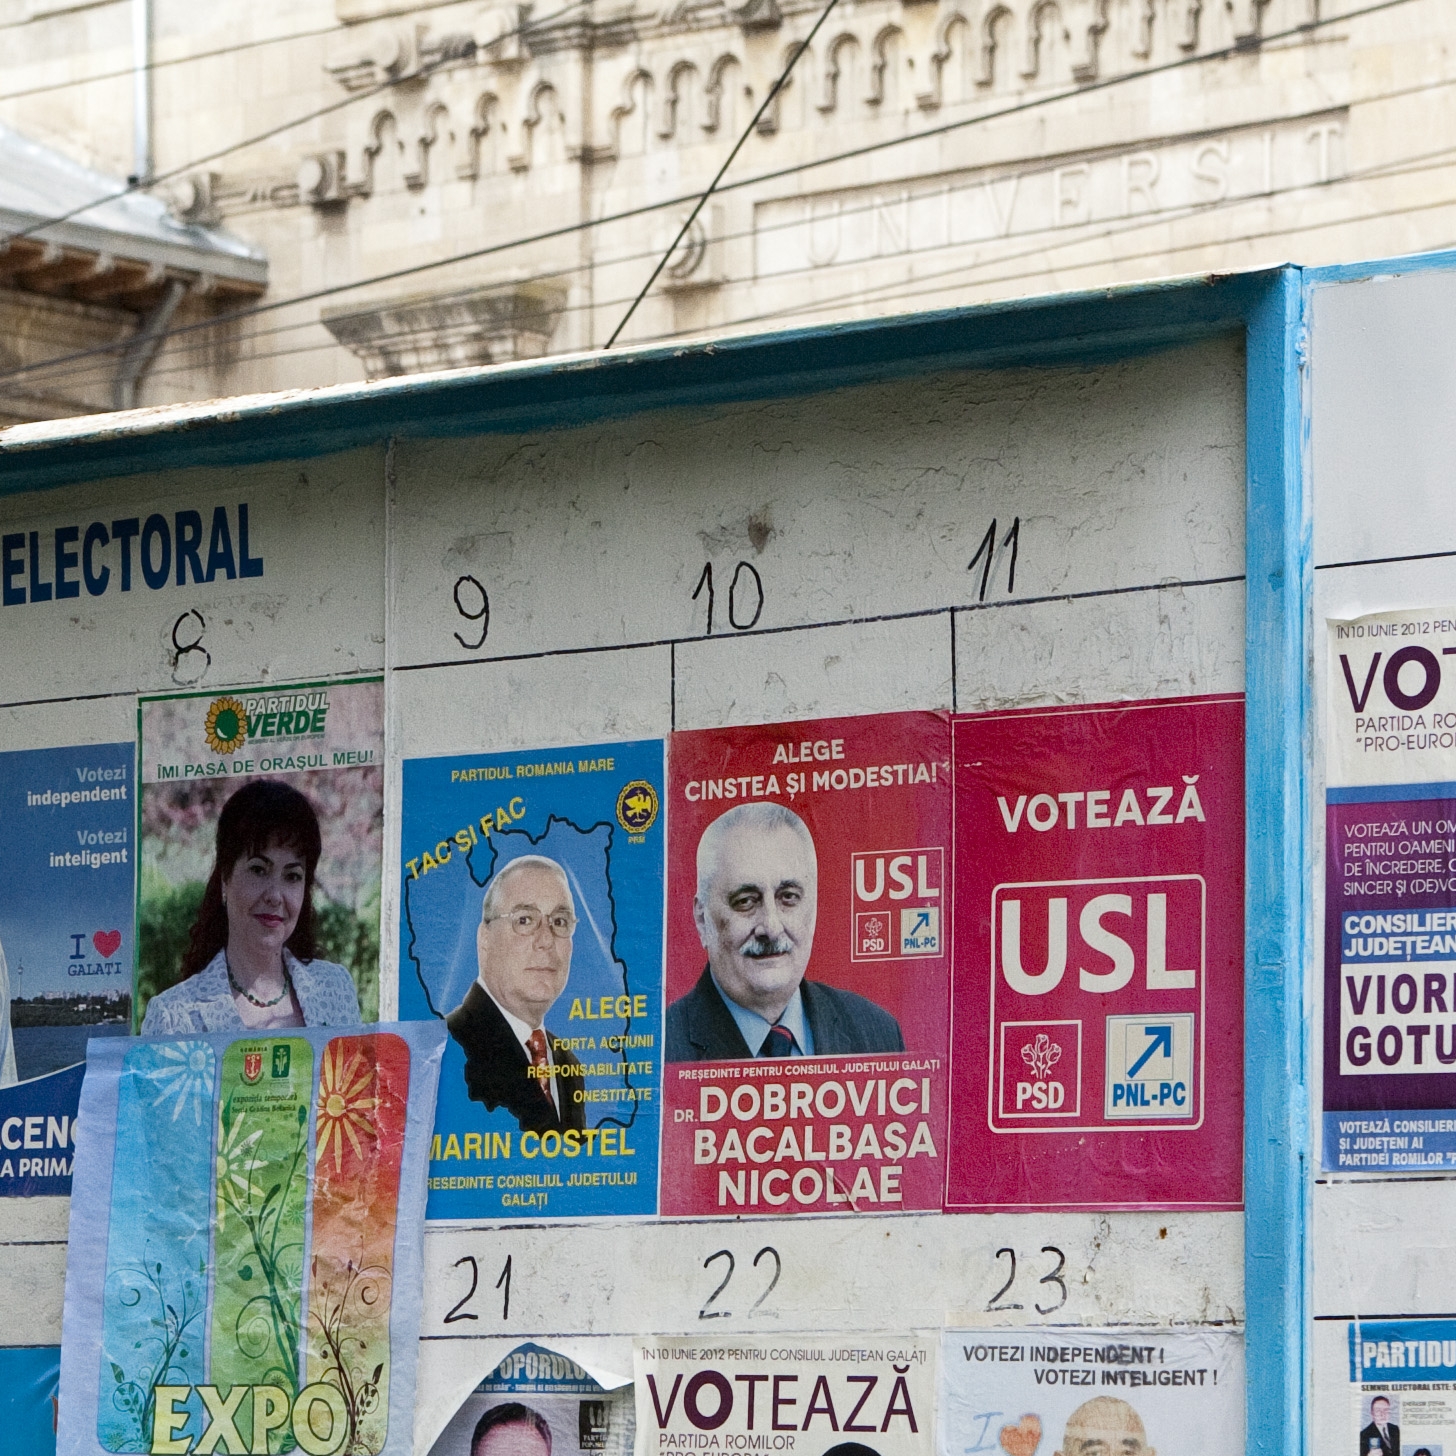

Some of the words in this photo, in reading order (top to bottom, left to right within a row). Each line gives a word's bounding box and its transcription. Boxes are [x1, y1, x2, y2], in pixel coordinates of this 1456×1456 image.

[2, 503, 264, 606] ELECTORAL
[968, 516, 1019, 601] 11
[454, 575, 489, 649] 9
[692, 561, 763, 634] 10
[171, 608, 211, 687] 8
[246, 692, 330, 716] PARTIDUL
[246, 709, 327, 738] VERDE
[156, 761, 180, 779] ÎMI
[232, 758, 254, 774] DE
[259, 751, 328, 772] ORAȘUL
[333, 749, 374, 766] MEU!
[773, 739, 845, 765] ALEGE
[76, 766, 126, 784] Votezi
[451, 767, 512, 783] PARTIDUL
[516, 762, 575, 780] ROMANIA
[579, 759, 614, 773] MARE
[685, 776, 779, 801] CINSTEA
[786, 772, 805, 800] ȘI
[813, 762, 937, 792] MODESTIA!
[27, 784, 126, 808] independent
[997, 774, 1206, 833] VOTEAZĂ
[77, 828, 127, 845] Votezi
[405, 841, 451, 880] TAC
[455, 826, 478, 853] SI
[479, 796, 526, 838] FAC
[49, 848, 127, 870] inteligent
[855, 855, 939, 901] USL
[862, 939, 884, 951] PSD
[904, 937, 936, 949] PNL-PC
[1002, 892, 1195, 995] USL
[68, 961, 122, 977] GALAȚI
[569, 996, 647, 1020] ALEGE
[528, 1062, 652, 1078] RESPONSABILITATE
[574, 1088, 651, 1103] ONESTITATE
[674, 1110, 698, 1123] DR.
[700, 1077, 930, 1122] DOBROVICI
[1016, 1082, 1064, 1109] PSD
[1113, 1082, 1186, 1107] PNL-PC
[520, 1128, 635, 1158] COSTEL
[718, 1166, 902, 1206] NICOLAE
[444, 1255, 512, 1324] 21
[699, 1247, 781, 1320] 22
[984, 1246, 1067, 1315] 23
[1034, 1369, 1094, 1385] VOTEZI
[1101, 1369, 1207, 1387] INTELIGENT
[646, 1364, 918, 1433] VOTEAZĂ
[150, 1382, 346, 1456] EXPO
